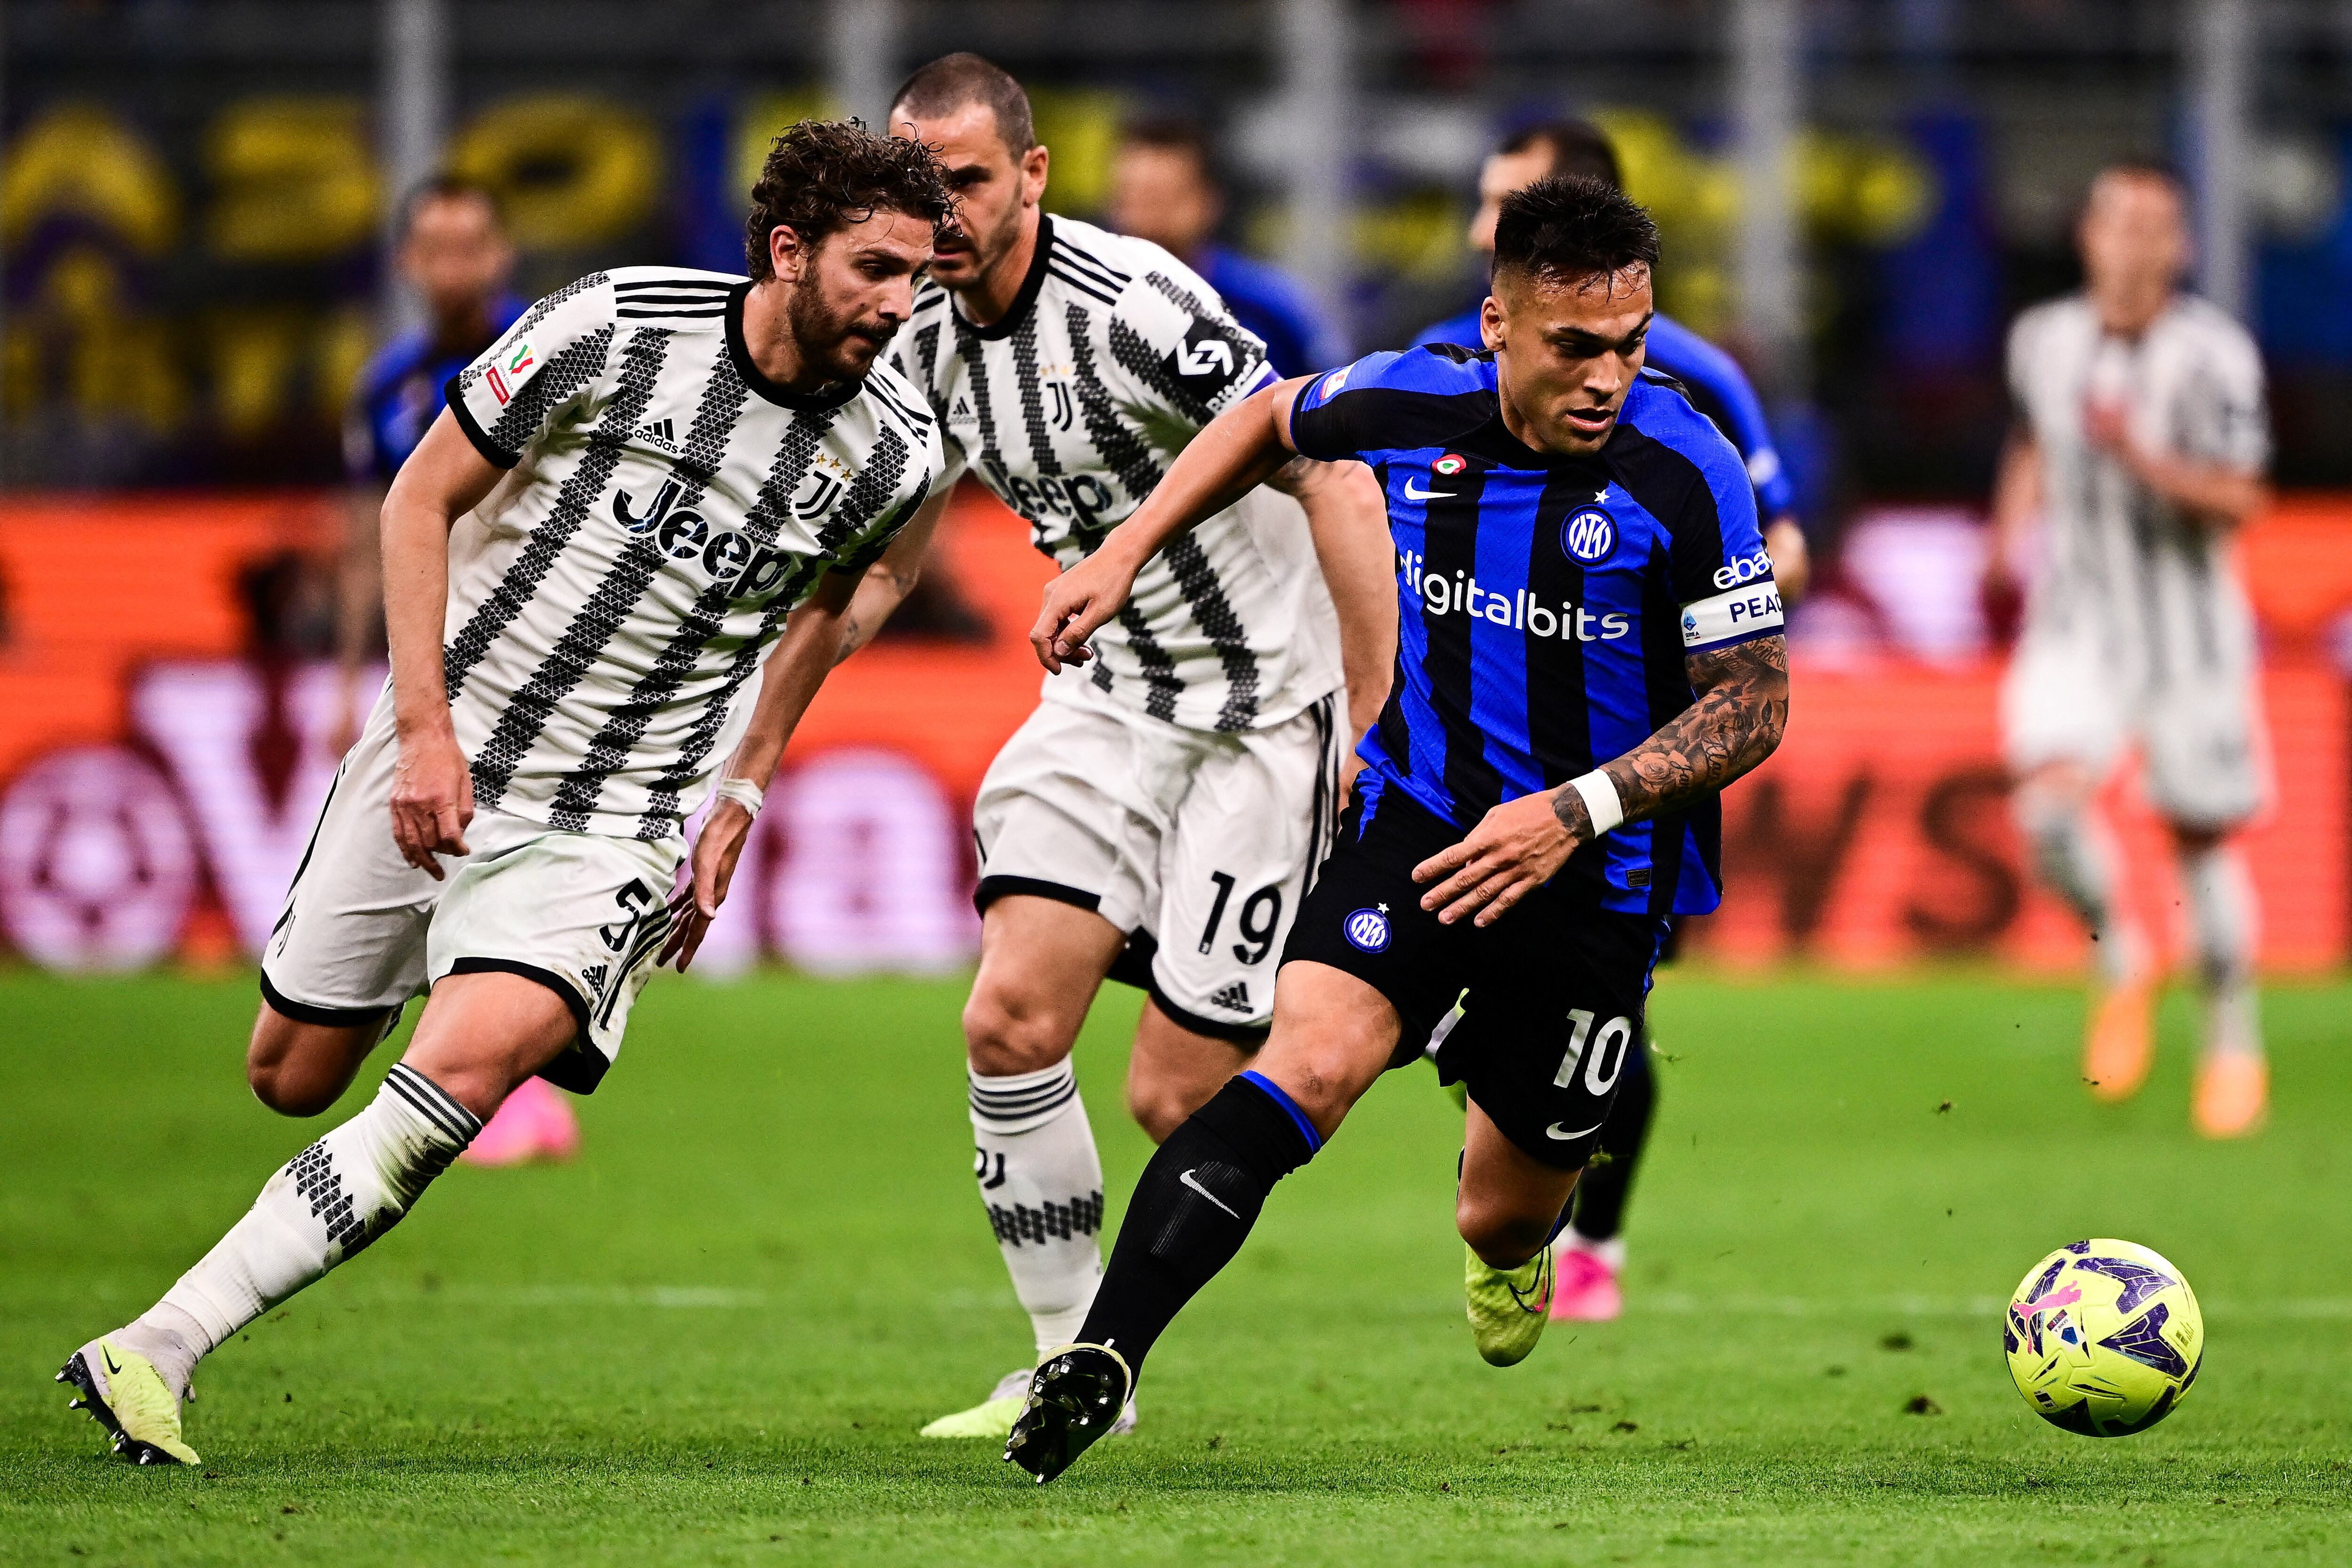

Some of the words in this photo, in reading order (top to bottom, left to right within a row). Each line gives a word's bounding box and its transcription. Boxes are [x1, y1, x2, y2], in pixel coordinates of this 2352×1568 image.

[498, 363, 506, 378] COPPA
[504, 377, 514, 391] ITALIA
[634, 429, 679, 454] adidas
[612, 478, 792, 598] Jeep
[1400, 549, 1629, 641] digitalbits
[599, 877, 652, 952] 5
[1198, 871, 1281, 964] 19
[1553, 1008, 1631, 1096] 10
